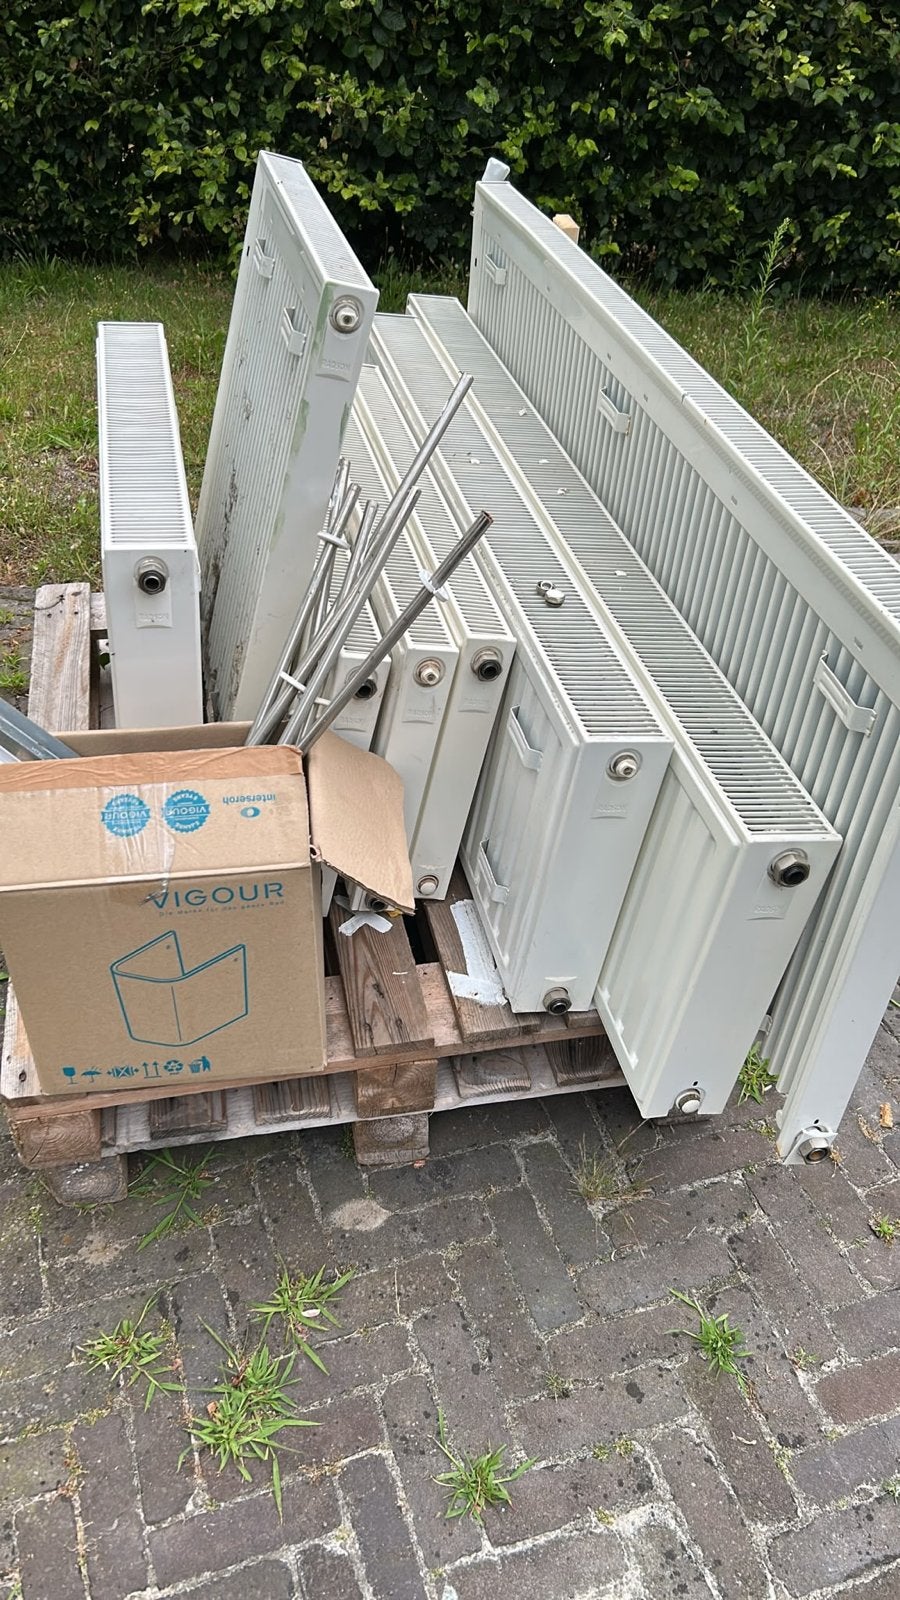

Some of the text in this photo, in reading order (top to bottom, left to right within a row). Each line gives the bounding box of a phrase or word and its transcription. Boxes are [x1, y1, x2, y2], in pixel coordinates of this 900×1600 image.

[222, 794, 276, 805] interseroh
[104, 810, 147, 820] VIGOUR
[165, 806, 207, 815] VIGOUR
[151, 882, 284, 909] VIGOUR
